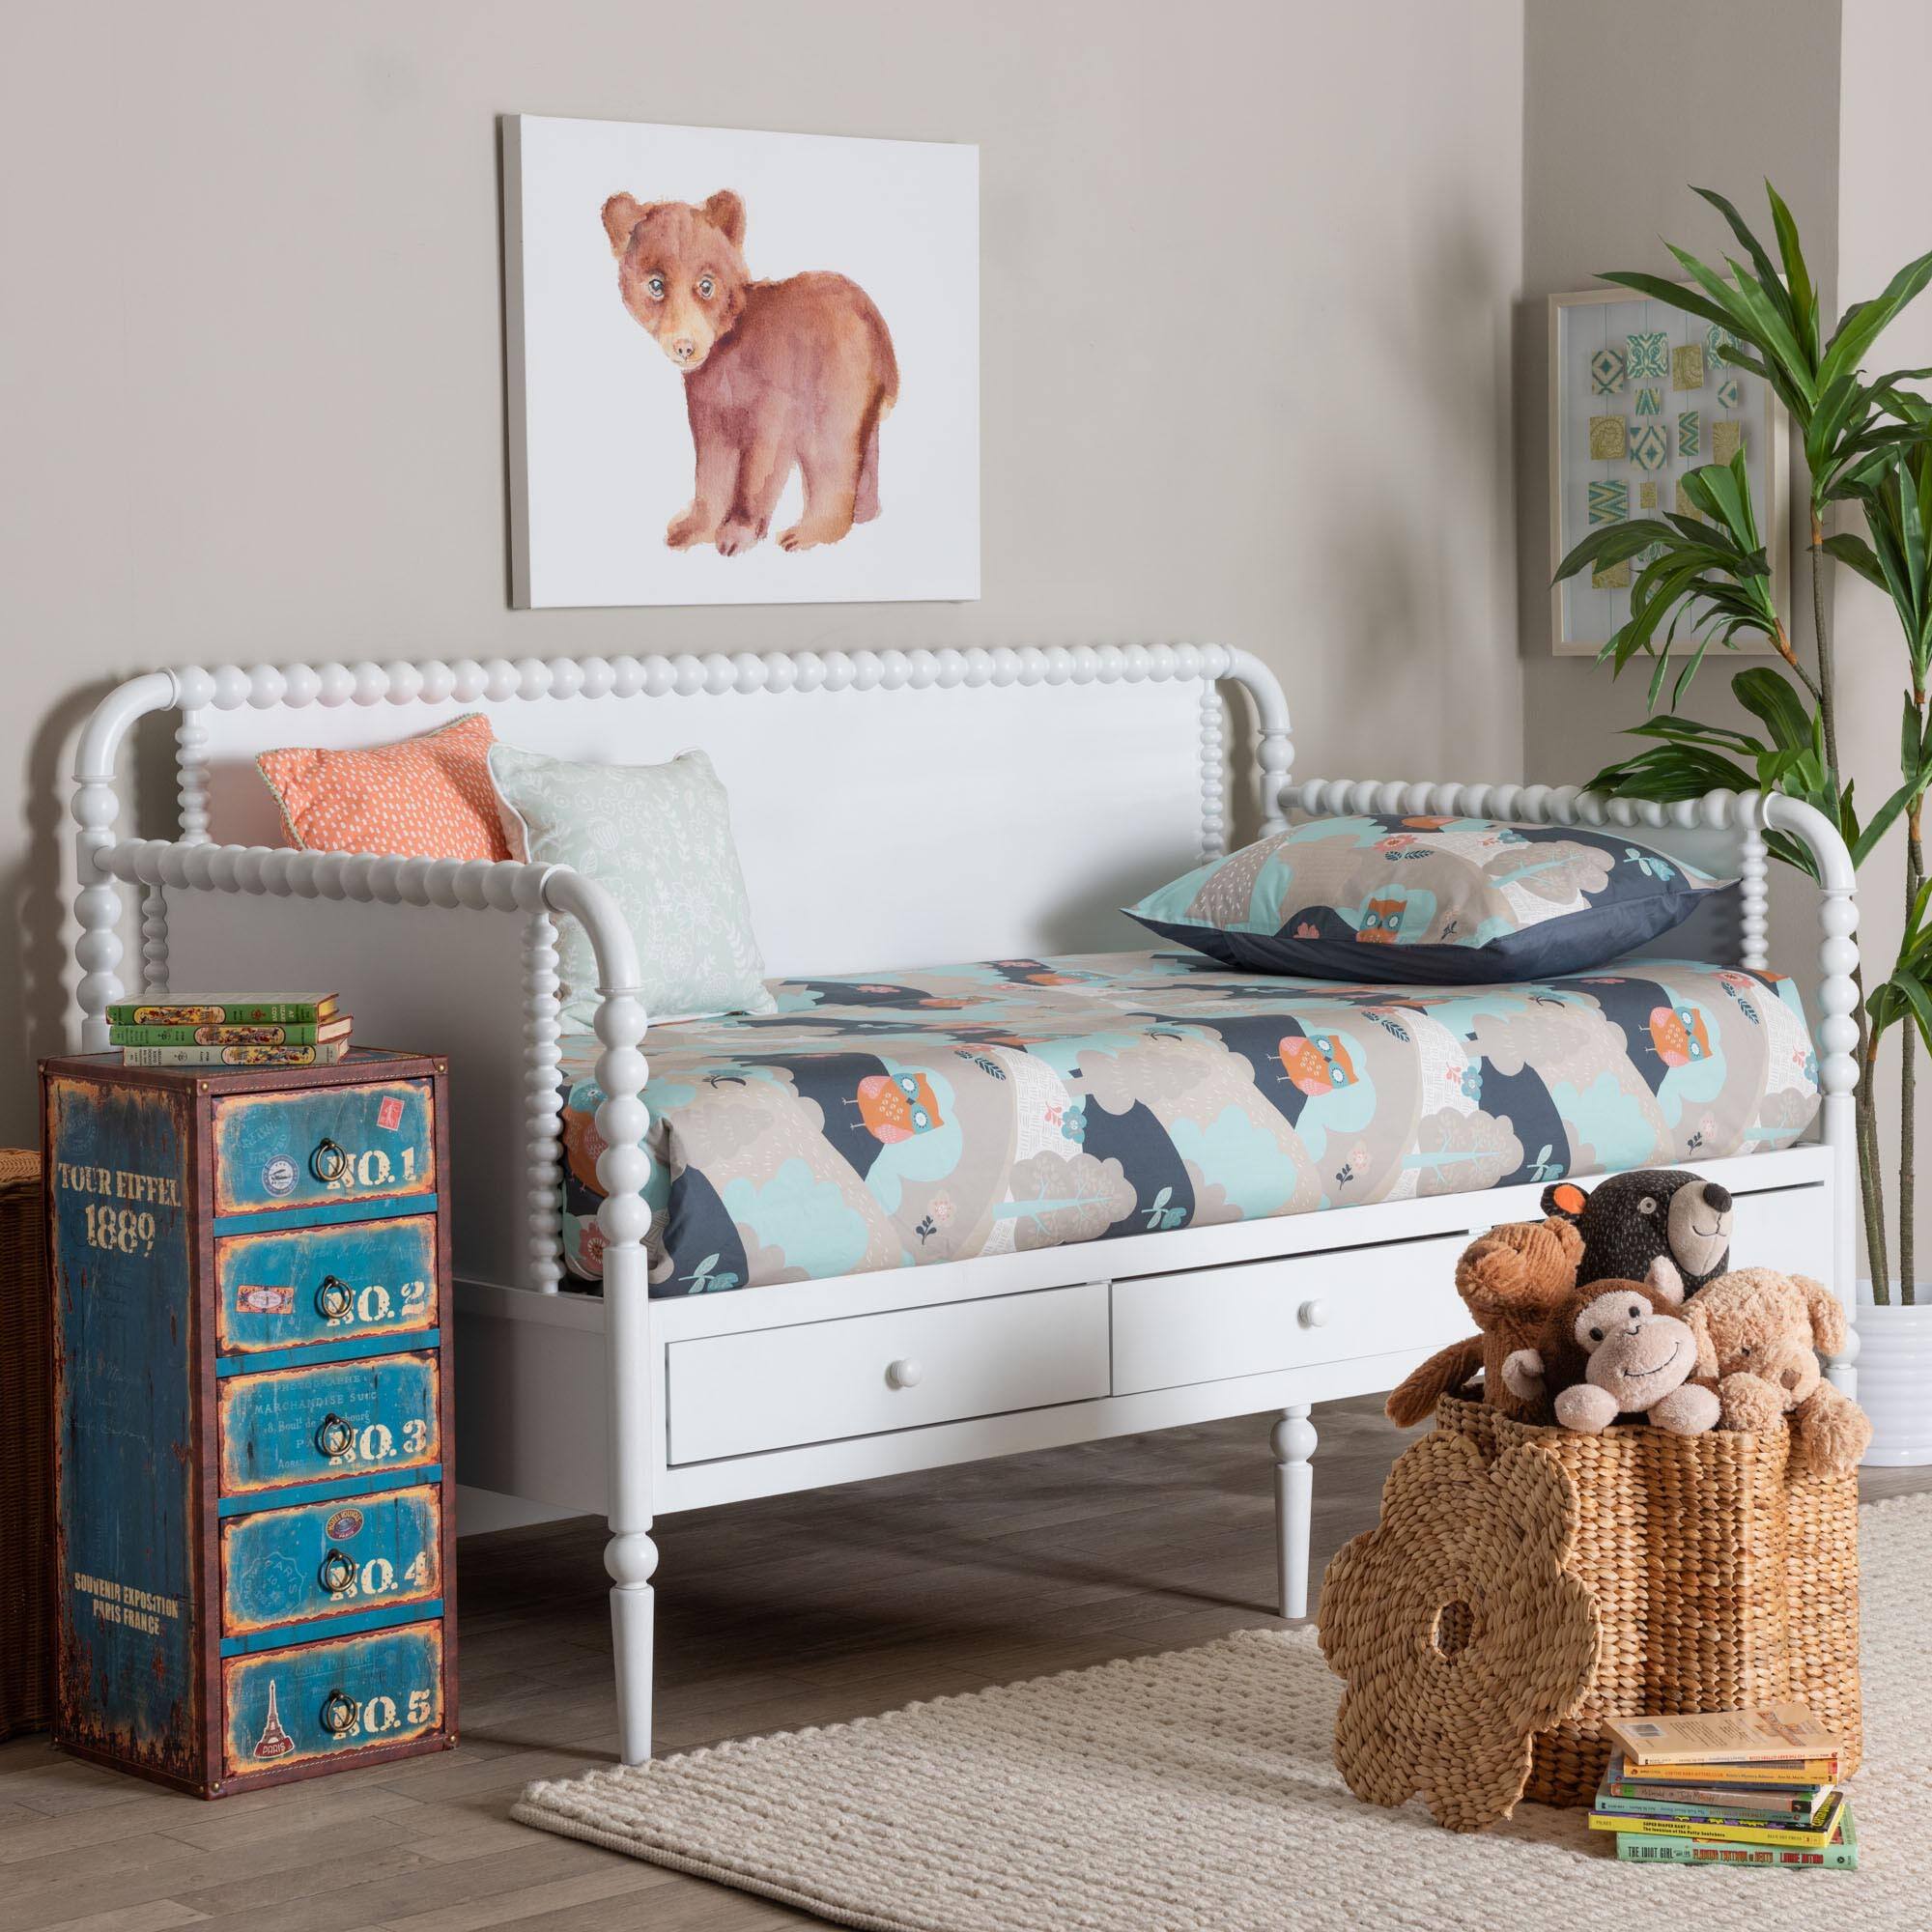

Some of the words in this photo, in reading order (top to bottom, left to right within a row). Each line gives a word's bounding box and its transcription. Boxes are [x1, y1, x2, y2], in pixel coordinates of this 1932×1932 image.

[58, 1163, 112, 1196] TOUR
[116, 1171, 181, 1207] EIFFEL
[85, 1204, 156, 1258] 1889
[255, 1394, 344, 1415] MARCHANDISE
[74, 1573, 121, 1602] SOUVENIR
[124, 1586, 179, 1619] EXPOSITION
[93, 1599, 122, 1624] PARIS
[124, 1608, 160, 1635] FRANCE
[262, 1742, 286, 1754] PARIS
[1628, 1846, 1639, 1858] THE
[1642, 1847, 1658, 1858] IDIOT
[1660, 1847, 1674, 1860] GIRL
